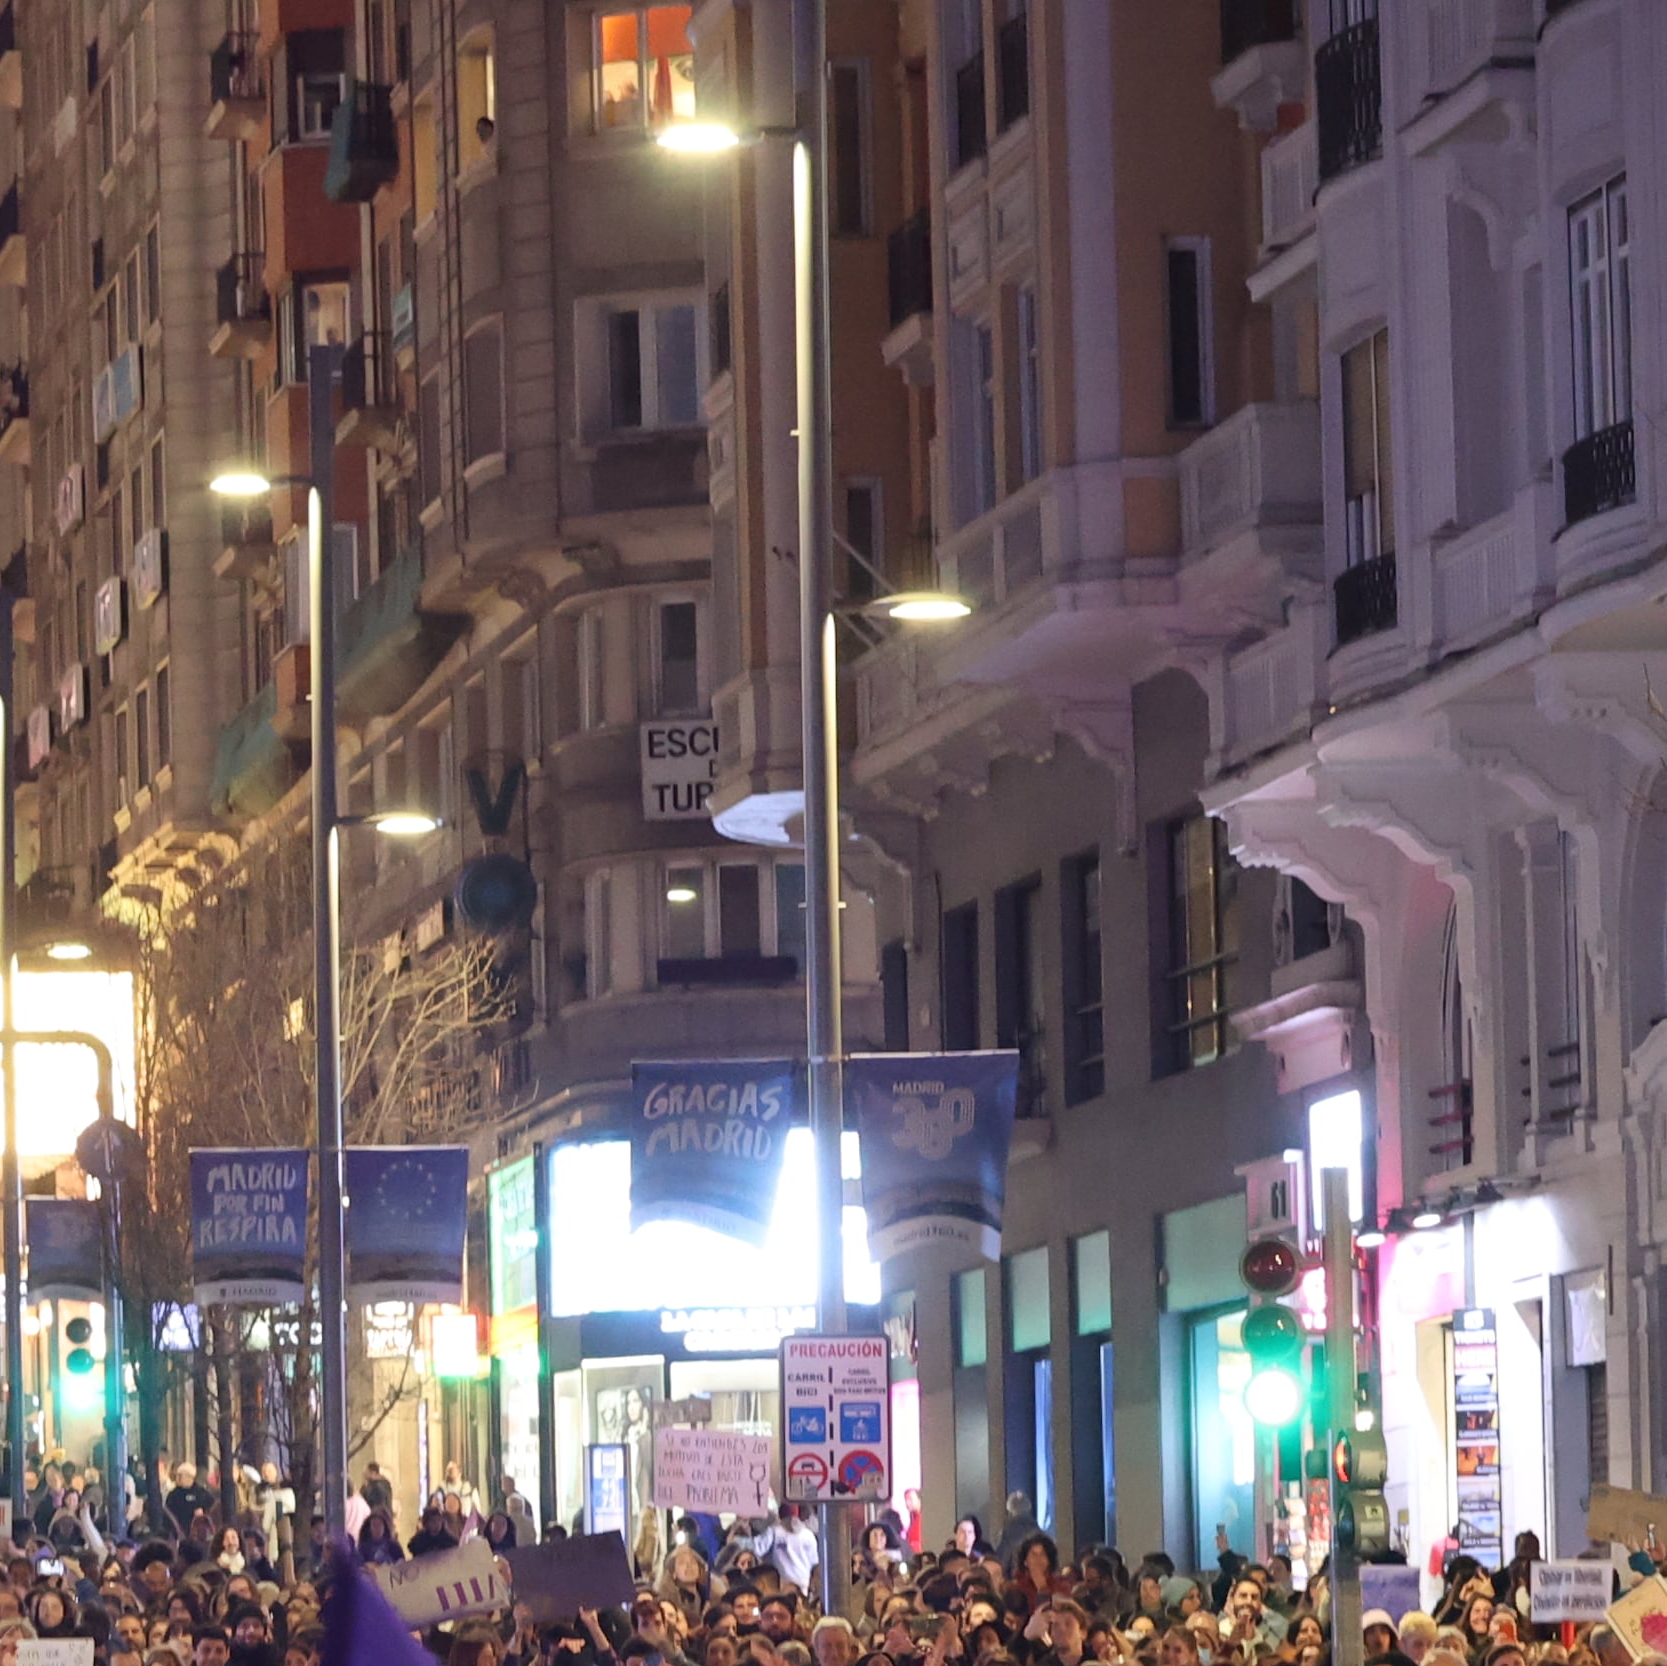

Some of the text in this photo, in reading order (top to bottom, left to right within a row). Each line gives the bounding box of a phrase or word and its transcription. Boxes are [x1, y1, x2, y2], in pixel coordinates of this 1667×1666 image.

[892, 1080, 945, 1094] MADRID
[642, 1081, 782, 1121] GRACIAS
[646, 1118, 771, 1160] MADRID
[206, 1163, 297, 1193] MADRID
[213, 1193, 285, 1216] POR FIN
[1271, 1180, 1287, 1219] 61
[199, 1216, 298, 1248] RESPIRA
[789, 1341, 883, 1358] PRECAUCIÓN
[788, 1373, 826, 1383] CARRIL
[796, 1387, 818, 1397] BICI
[687, 1484, 740, 1505] PROBLEMA
[389, 1563, 420, 1588] NO
